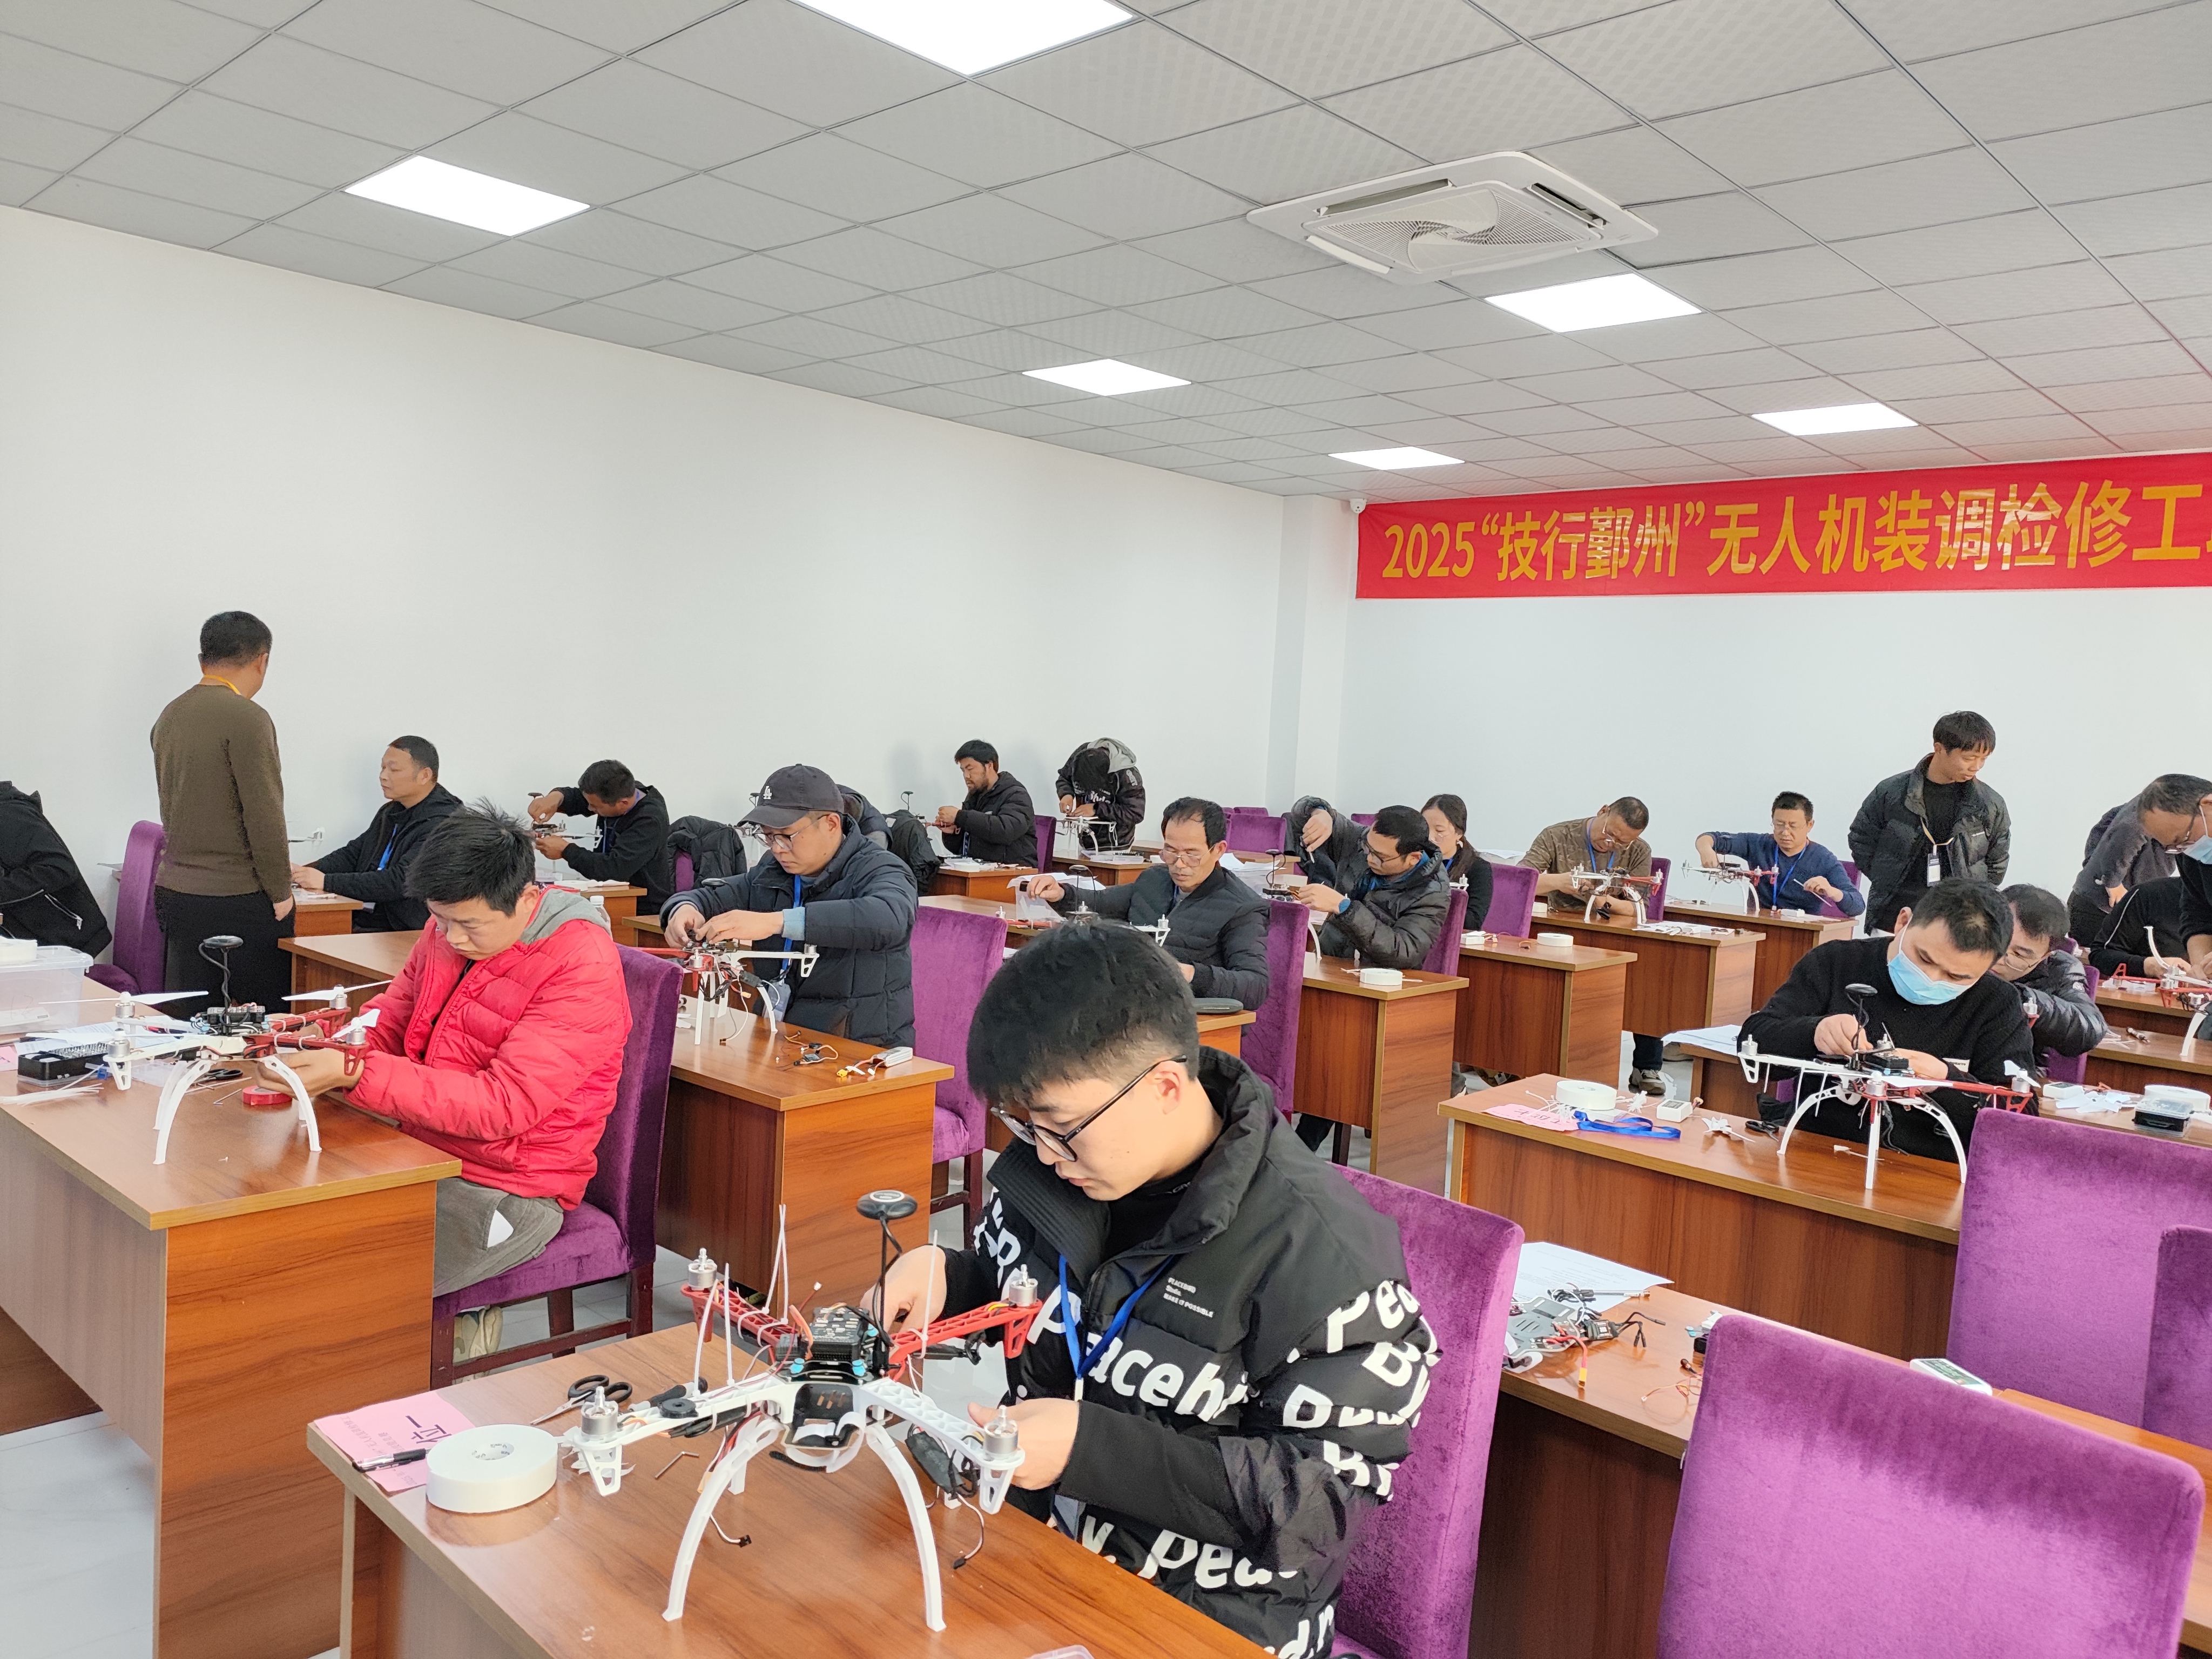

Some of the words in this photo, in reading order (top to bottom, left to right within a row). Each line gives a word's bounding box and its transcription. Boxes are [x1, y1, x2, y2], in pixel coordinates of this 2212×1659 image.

[1382, 479, 2212, 581] 2025“技行鄞州”无人机装调检修工
[763, 785, 772, 799] LA
[1184, 1301, 1213, 1318] POSSIBLE
